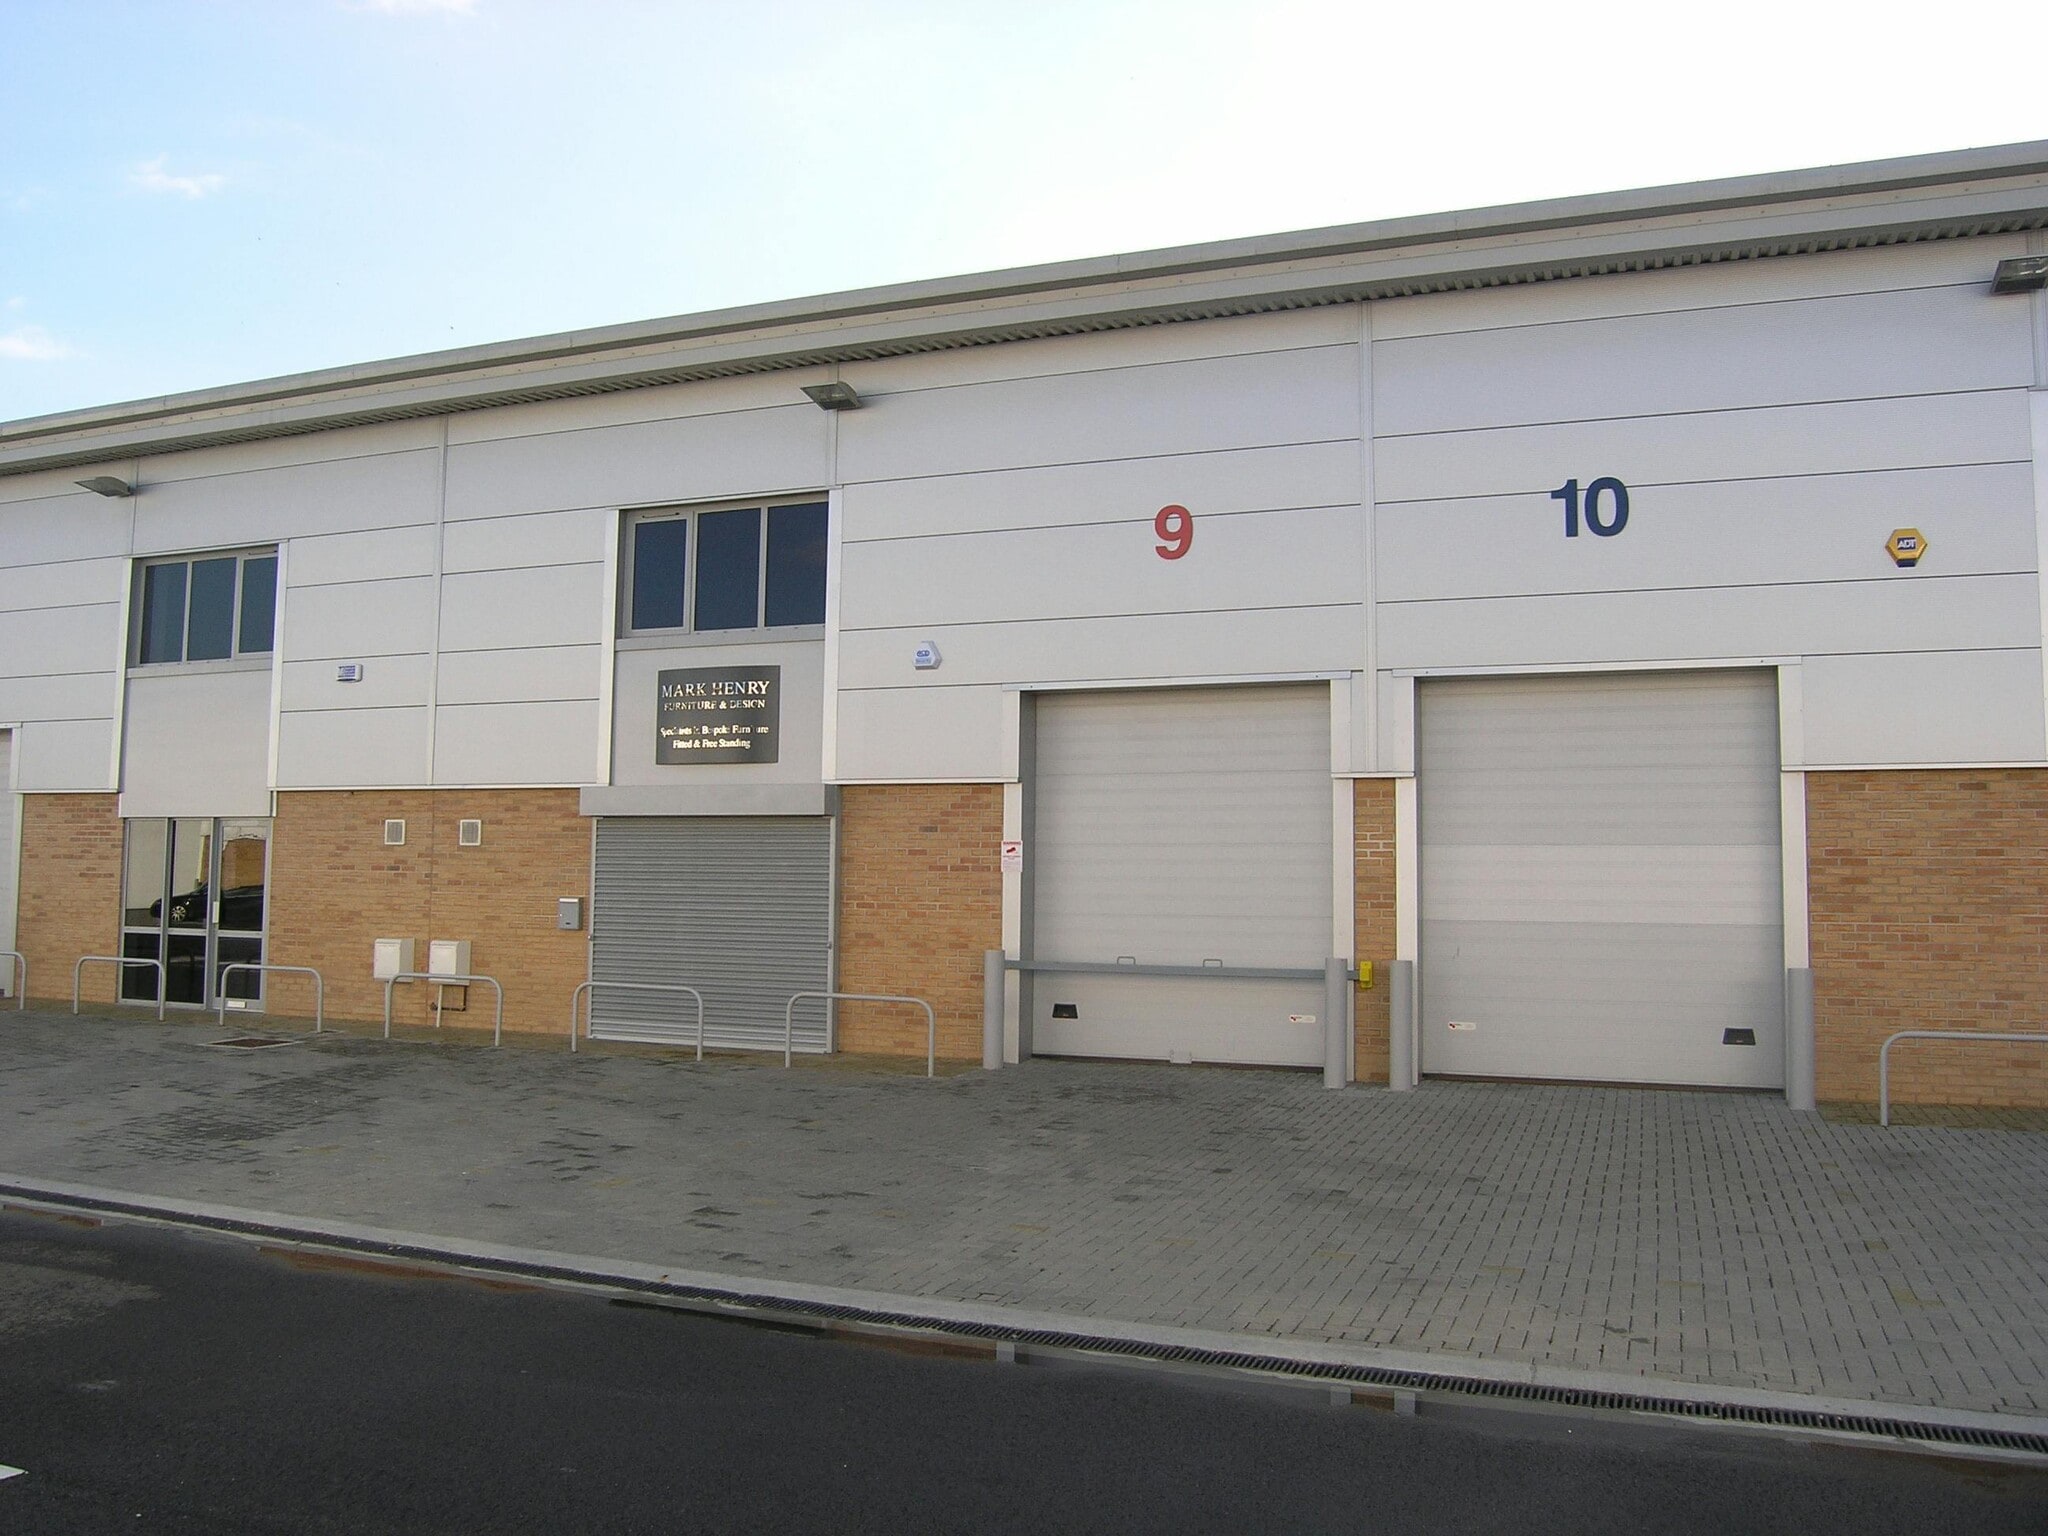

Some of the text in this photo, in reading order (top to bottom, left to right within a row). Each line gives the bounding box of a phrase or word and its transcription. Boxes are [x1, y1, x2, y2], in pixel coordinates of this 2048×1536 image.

[1551, 476, 1630, 538] 10
[1154, 504, 1194, 561] 9
[1897, 538, 1917, 549] ADT
[662, 680, 770, 698] MARK HENRY
[664, 699, 766, 712] FURNITURE & DESIGN
[693, 739, 701, 749] &
[702, 738, 718, 749] Free
[719, 738, 751, 750] Standing
